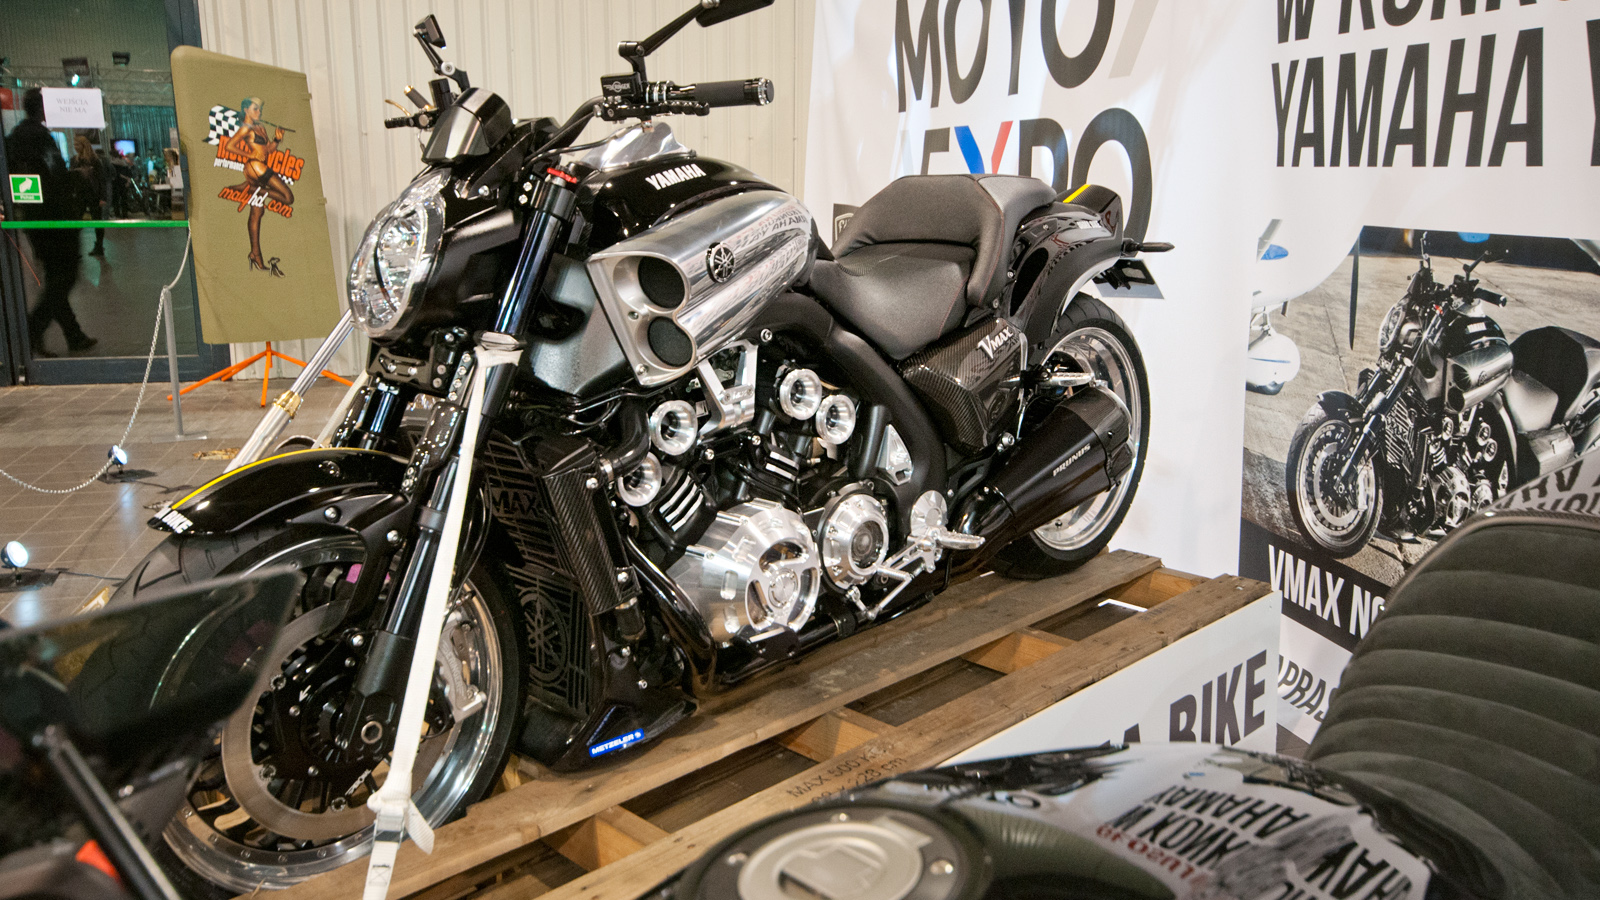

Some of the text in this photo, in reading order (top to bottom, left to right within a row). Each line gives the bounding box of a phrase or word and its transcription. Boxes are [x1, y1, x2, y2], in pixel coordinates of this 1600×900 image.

[1271, 27, 1543, 167] YAMAHA
[645, 163, 707, 191] YAMAHA
[1268, 544, 1345, 628] VMAX
[1169, 649, 1267, 746] BIKE
[591, 733, 635, 755] METZELER
[786, 775, 831, 798] MAX
[827, 759, 861, 777] 500
